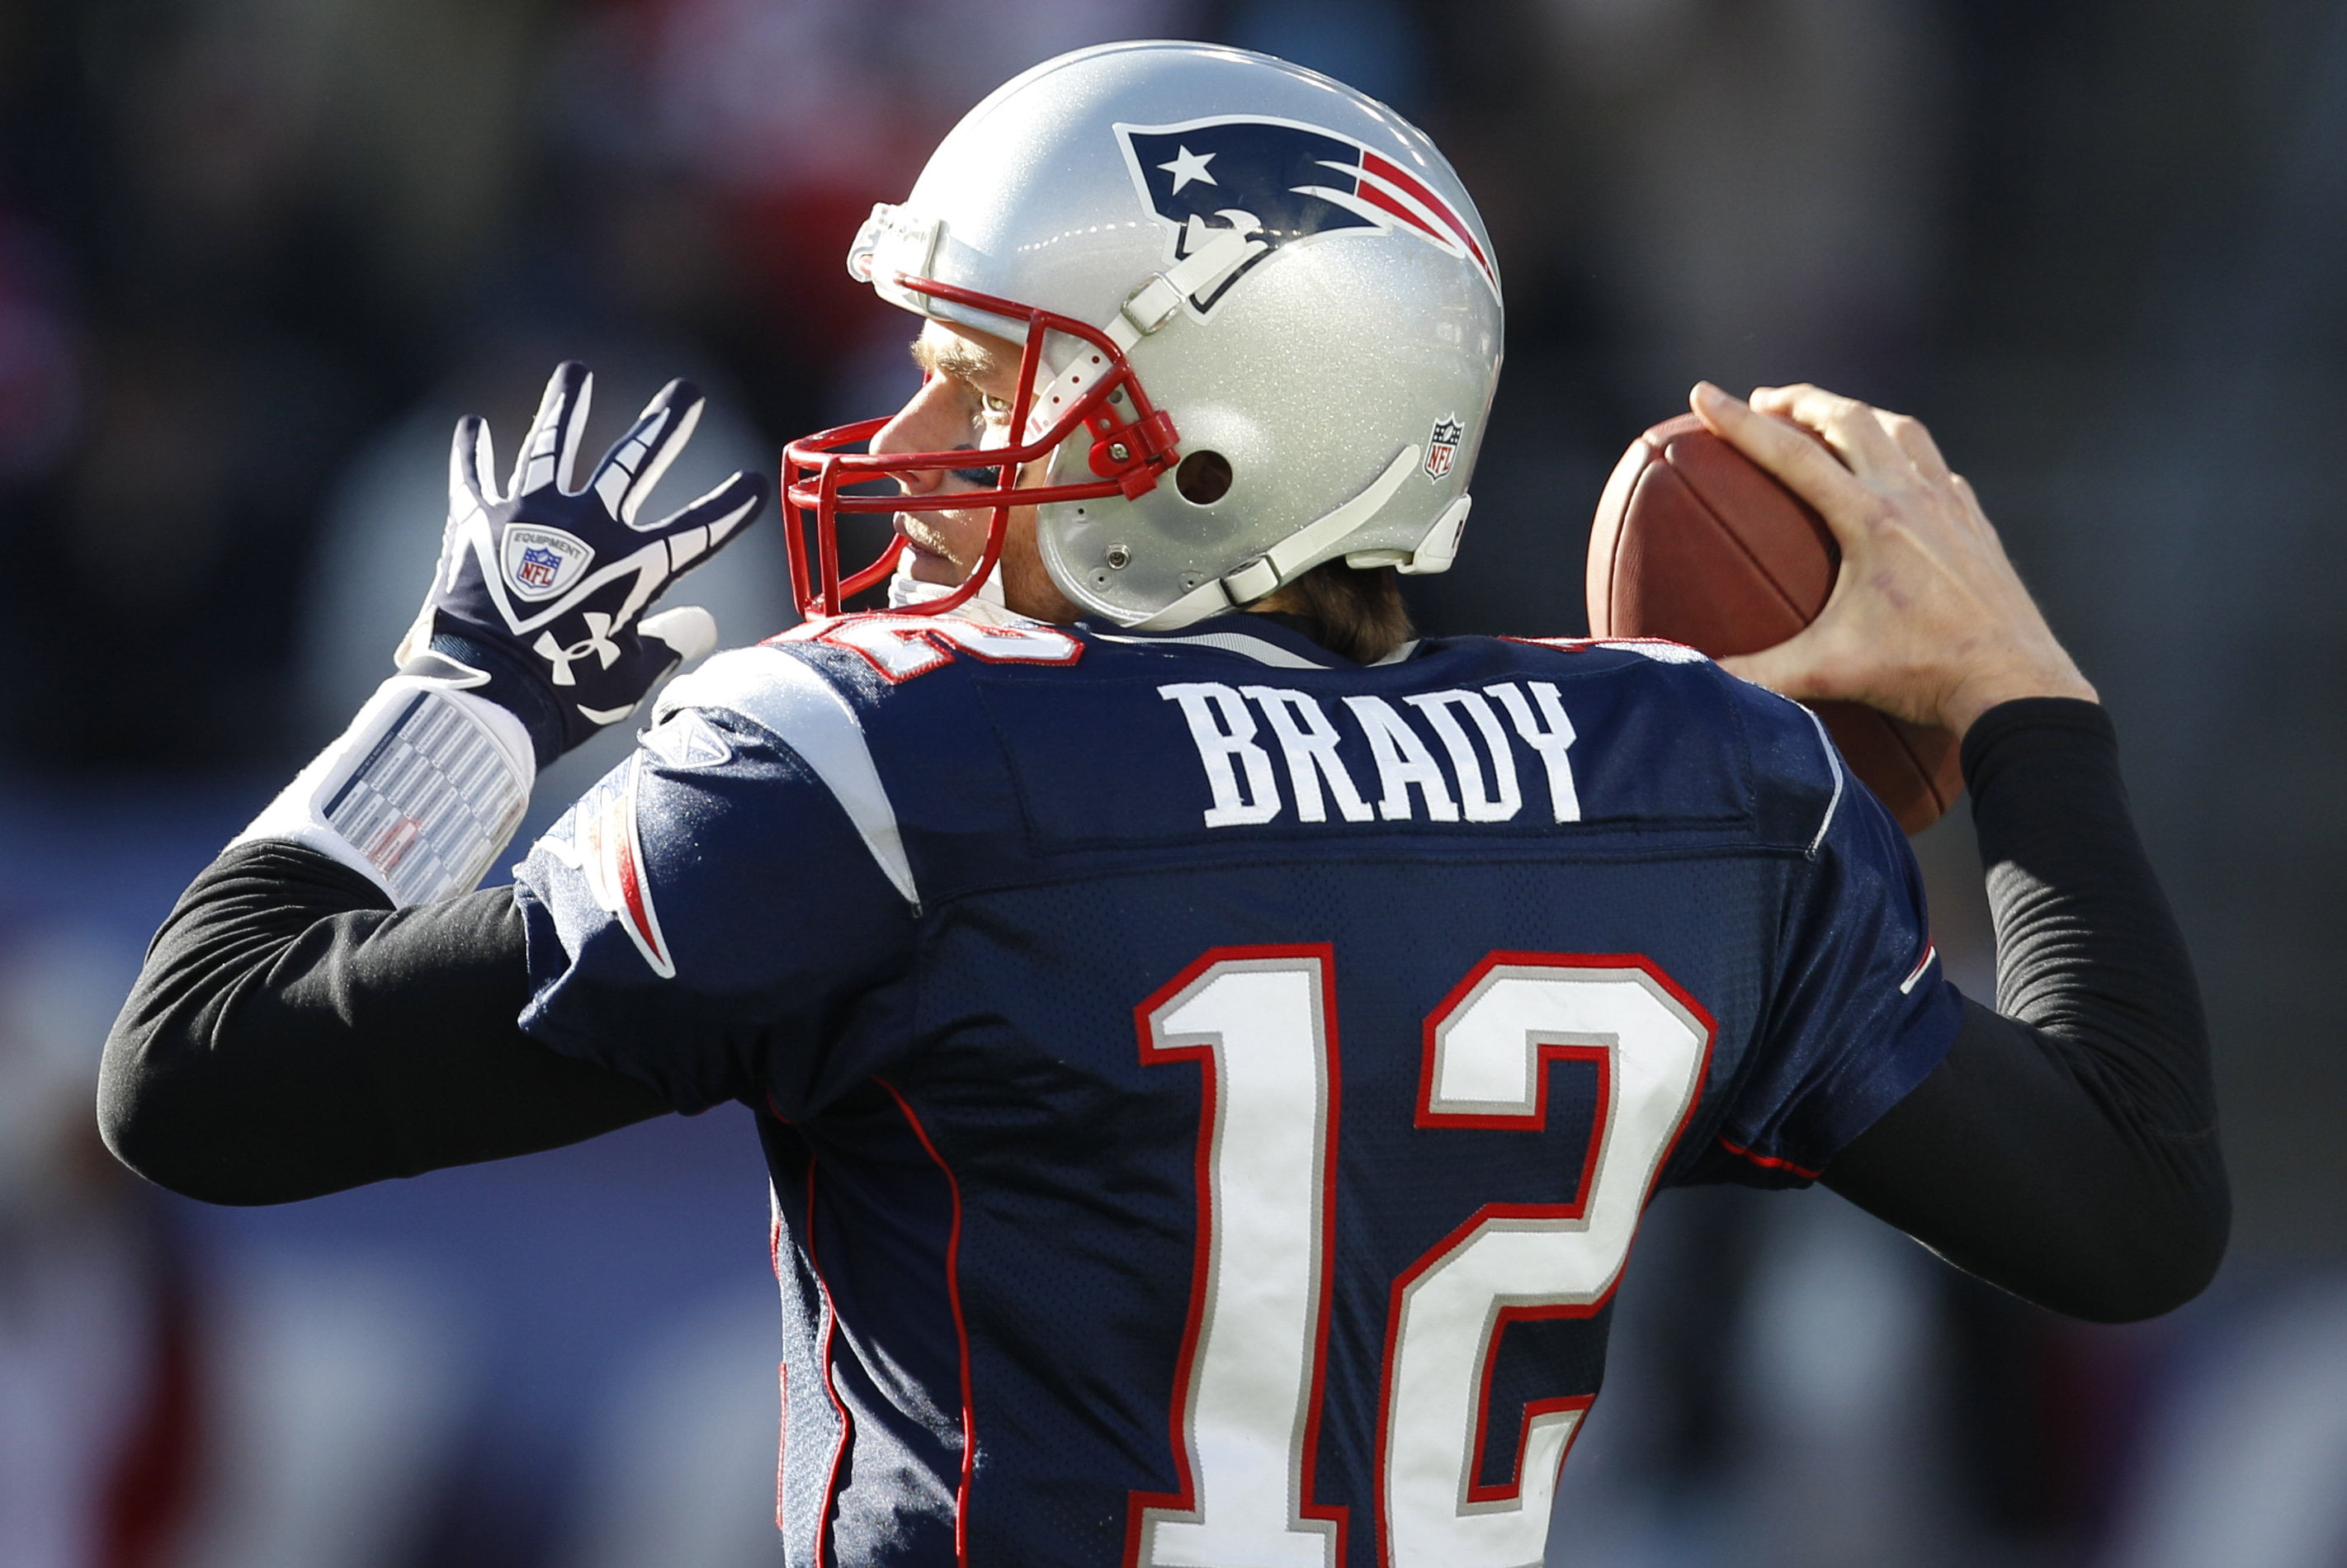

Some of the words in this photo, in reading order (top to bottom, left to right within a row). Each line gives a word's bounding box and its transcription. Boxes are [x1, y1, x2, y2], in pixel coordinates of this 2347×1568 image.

[1428, 445, 1452, 475] NFL
[513, 532, 582, 560] EQUIPMENT
[520, 562, 551, 585] NFL
[1156, 680, 1581, 829] BRADY
[1122, 942, 1719, 1568] 12
